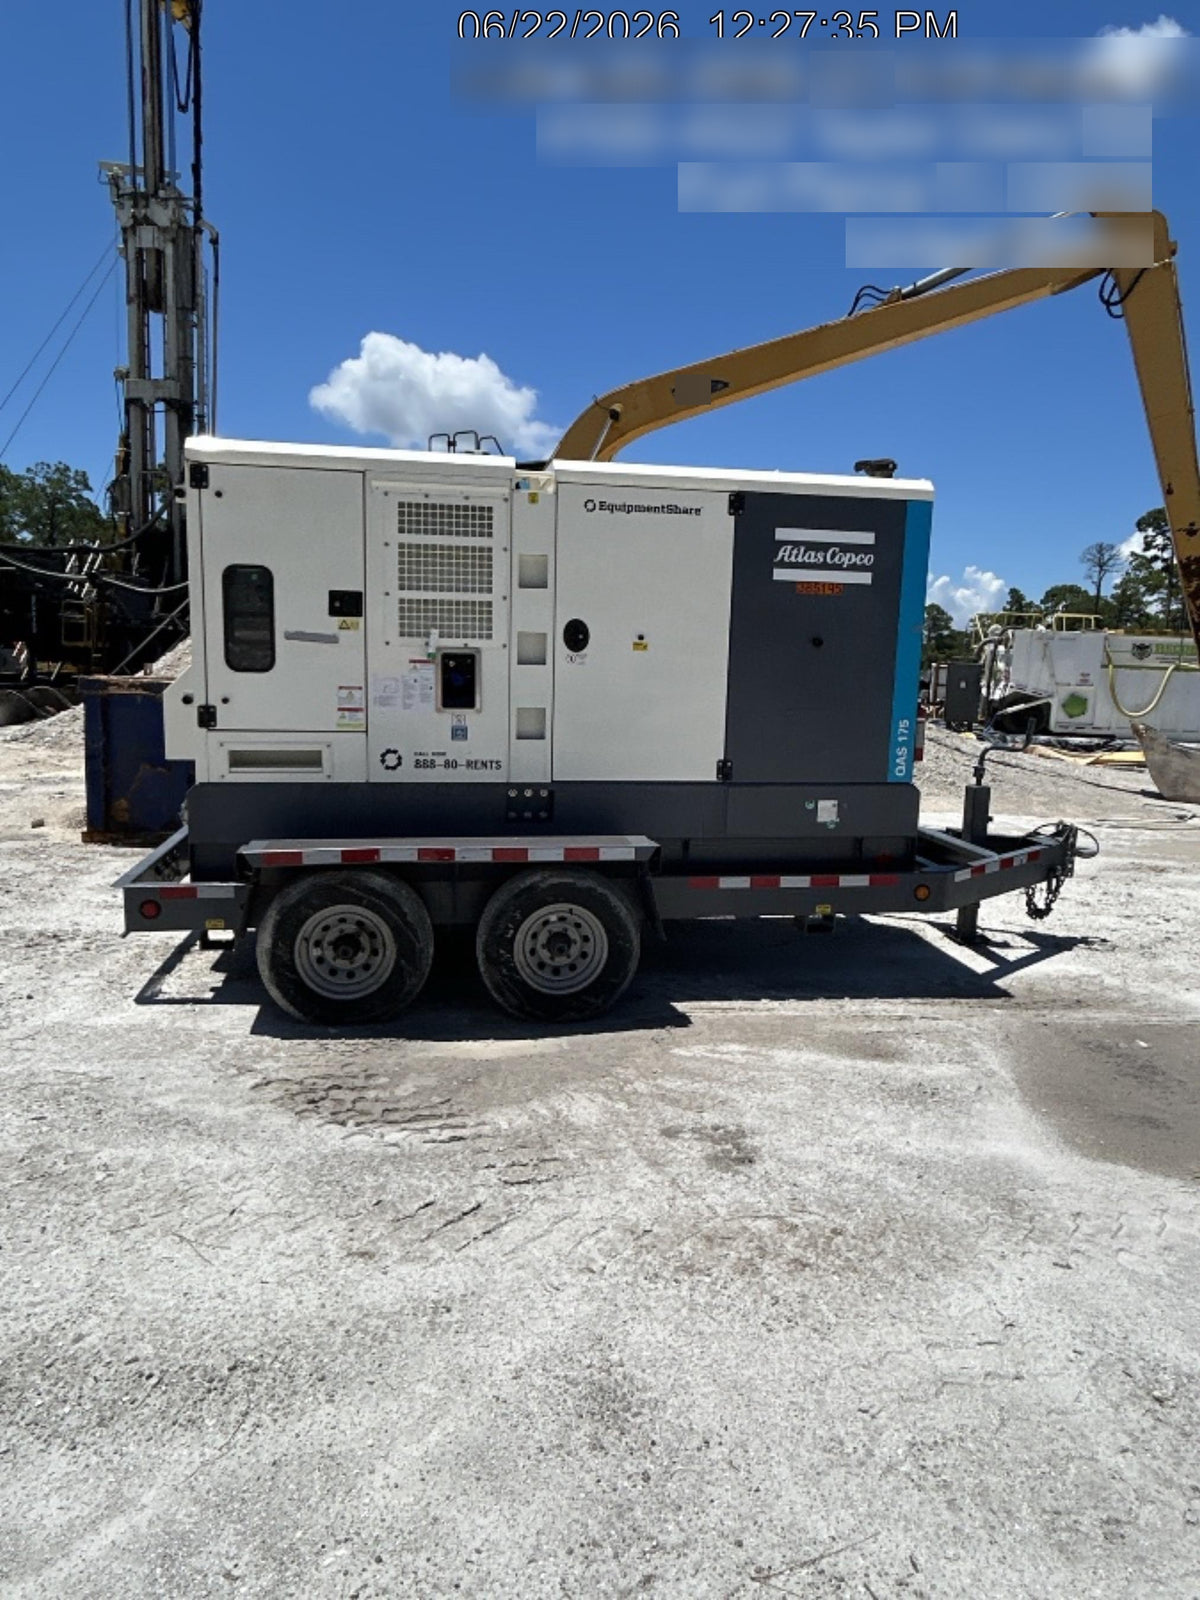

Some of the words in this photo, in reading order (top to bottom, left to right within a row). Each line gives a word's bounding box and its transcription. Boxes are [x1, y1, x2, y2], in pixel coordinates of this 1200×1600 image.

[598, 500, 702, 516] EquipmentShare
[773, 544, 825, 564] Atlas
[826, 546, 874, 568] Copco
[897, 719, 910, 742] 175
[413, 758, 502, 771] 888-80-RENTS
